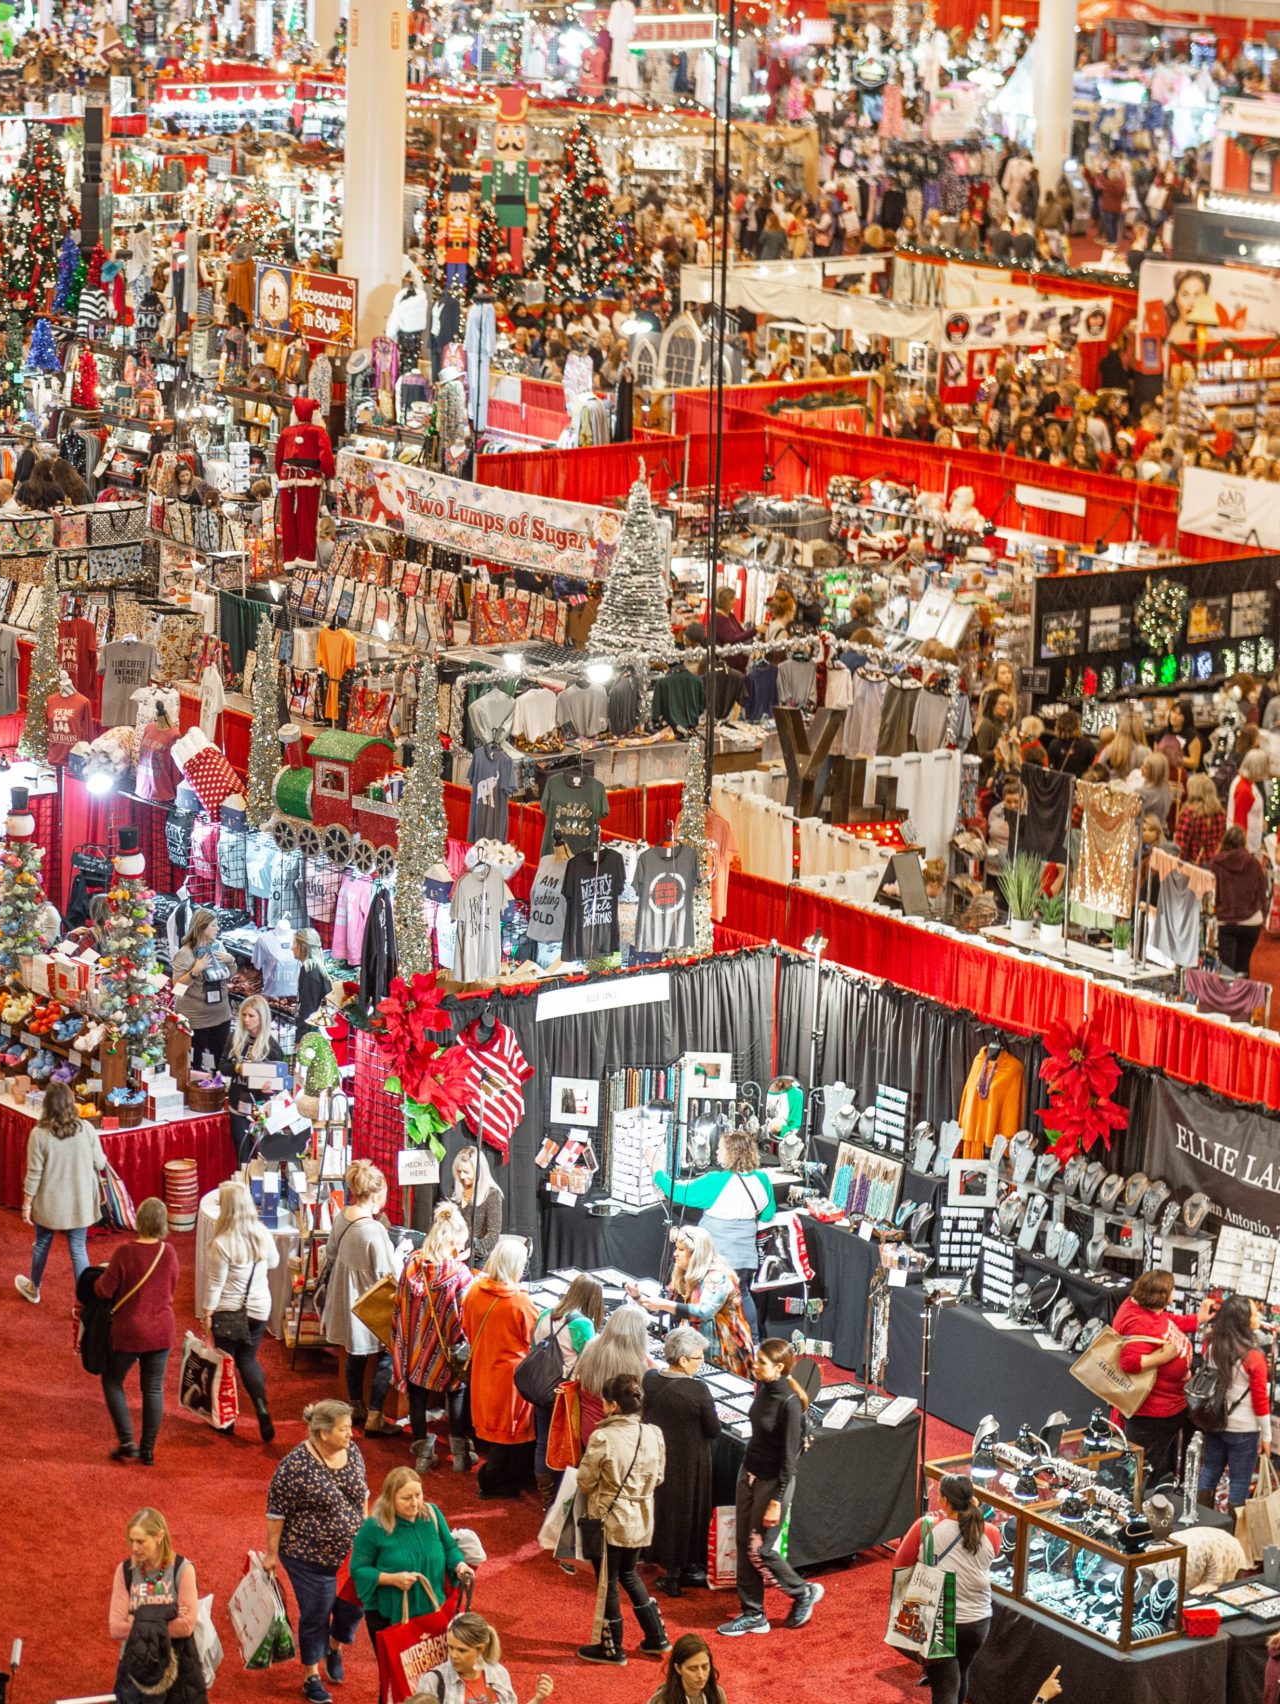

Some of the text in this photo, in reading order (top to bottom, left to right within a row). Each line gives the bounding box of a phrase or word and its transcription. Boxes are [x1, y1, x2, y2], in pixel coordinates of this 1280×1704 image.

[293, 282, 353, 311] Accessorize
[303, 307, 341, 334] in Style
[406, 486, 587, 553] Two Lumps of Sugar
[114, 660, 127, 669] LIKE
[127, 659, 146, 668] COFFEE
[114, 668, 144, 677] AND MAYBE
[122, 676, 140, 684] PEOPLE
[540, 874, 560, 890] AM
[581, 879, 613, 900] MERRY
[1175, 1122, 1240, 1178] ELLIE
[1224, 1207, 1274, 1238] Antonio,
[1095, 1357, 1132, 1392] Methodist
[130, 1581, 172, 1597] MERRY
[933, 1590, 945, 1647] Marsh
[399, 1632, 449, 1665] NUTCRACK
[403, 1647, 448, 1679] NUTCRAC
